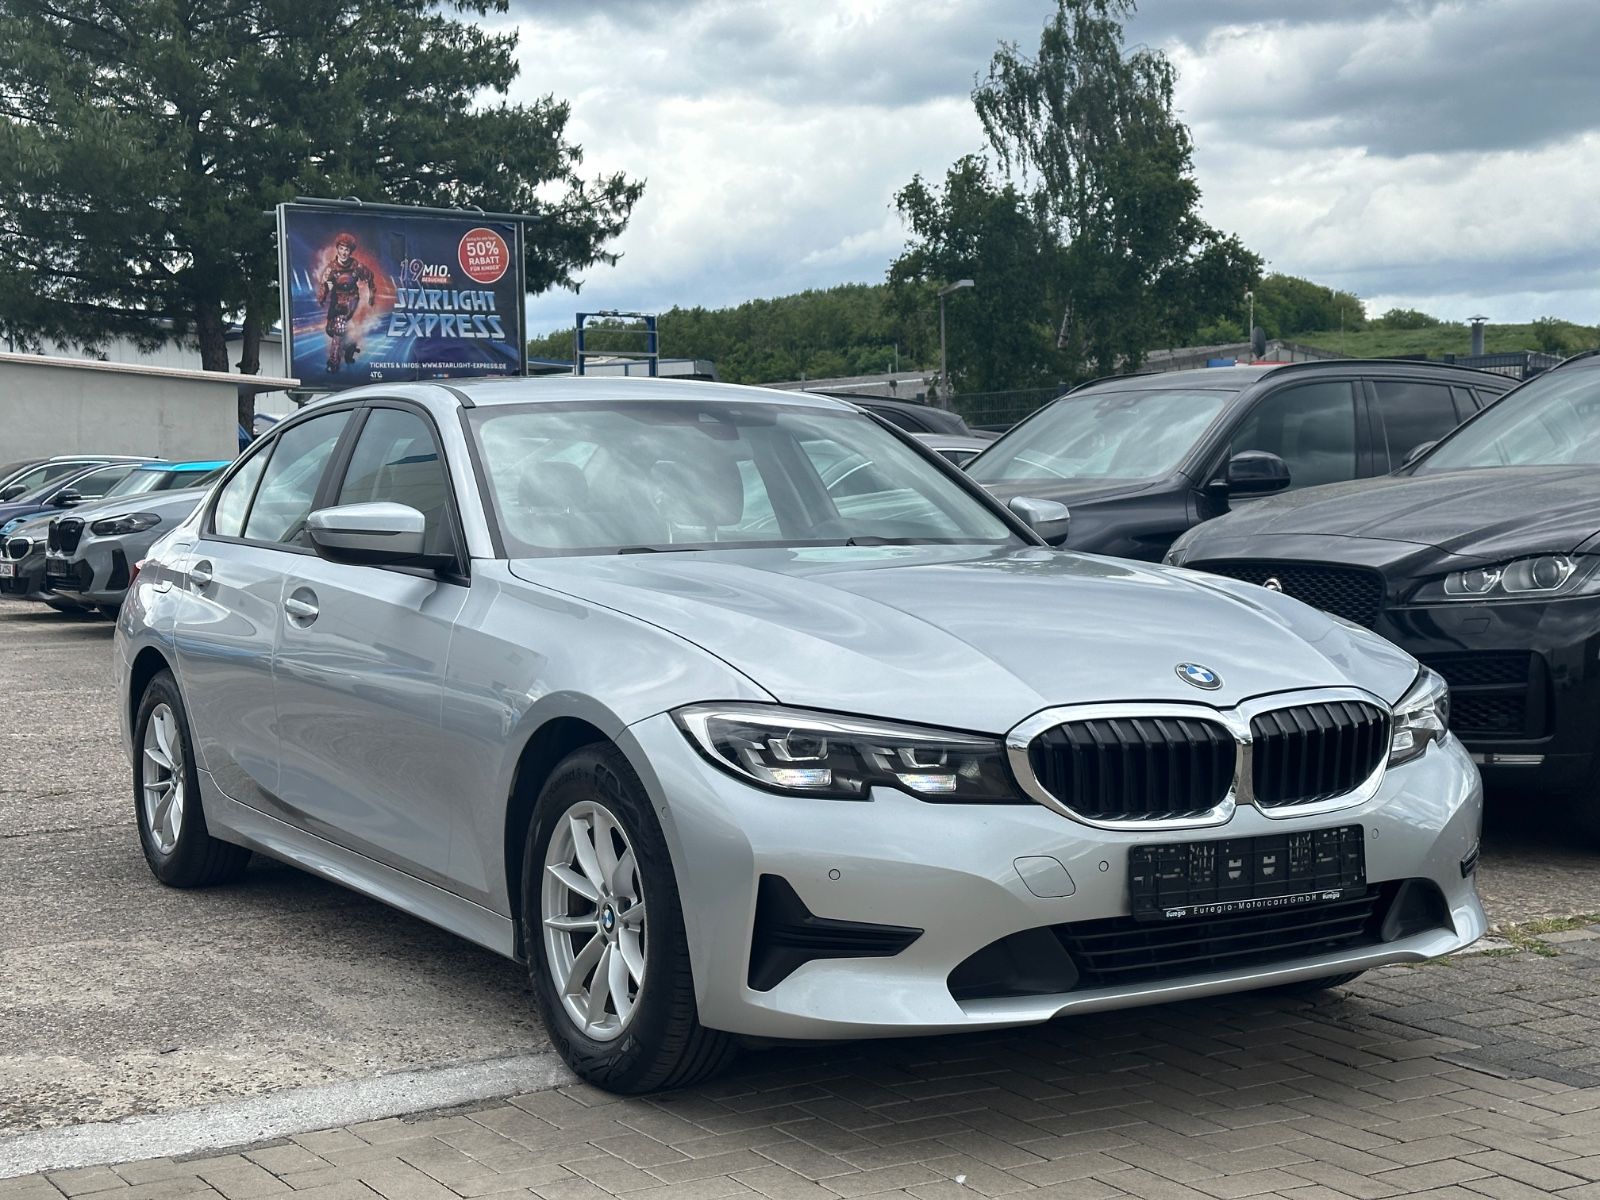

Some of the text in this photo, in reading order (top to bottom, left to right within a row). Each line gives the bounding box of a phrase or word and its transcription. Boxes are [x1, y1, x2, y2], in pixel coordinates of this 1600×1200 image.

[466, 241, 499, 256] 50%
[468, 256, 500, 265] RABATT
[423, 264, 451, 278] MIO.
[393, 288, 496, 311] STARLIGHT
[387, 312, 506, 339] EXPRESS
[369, 361, 395, 369] TICKETS
[1290, 894, 1317, 904] GmbH
